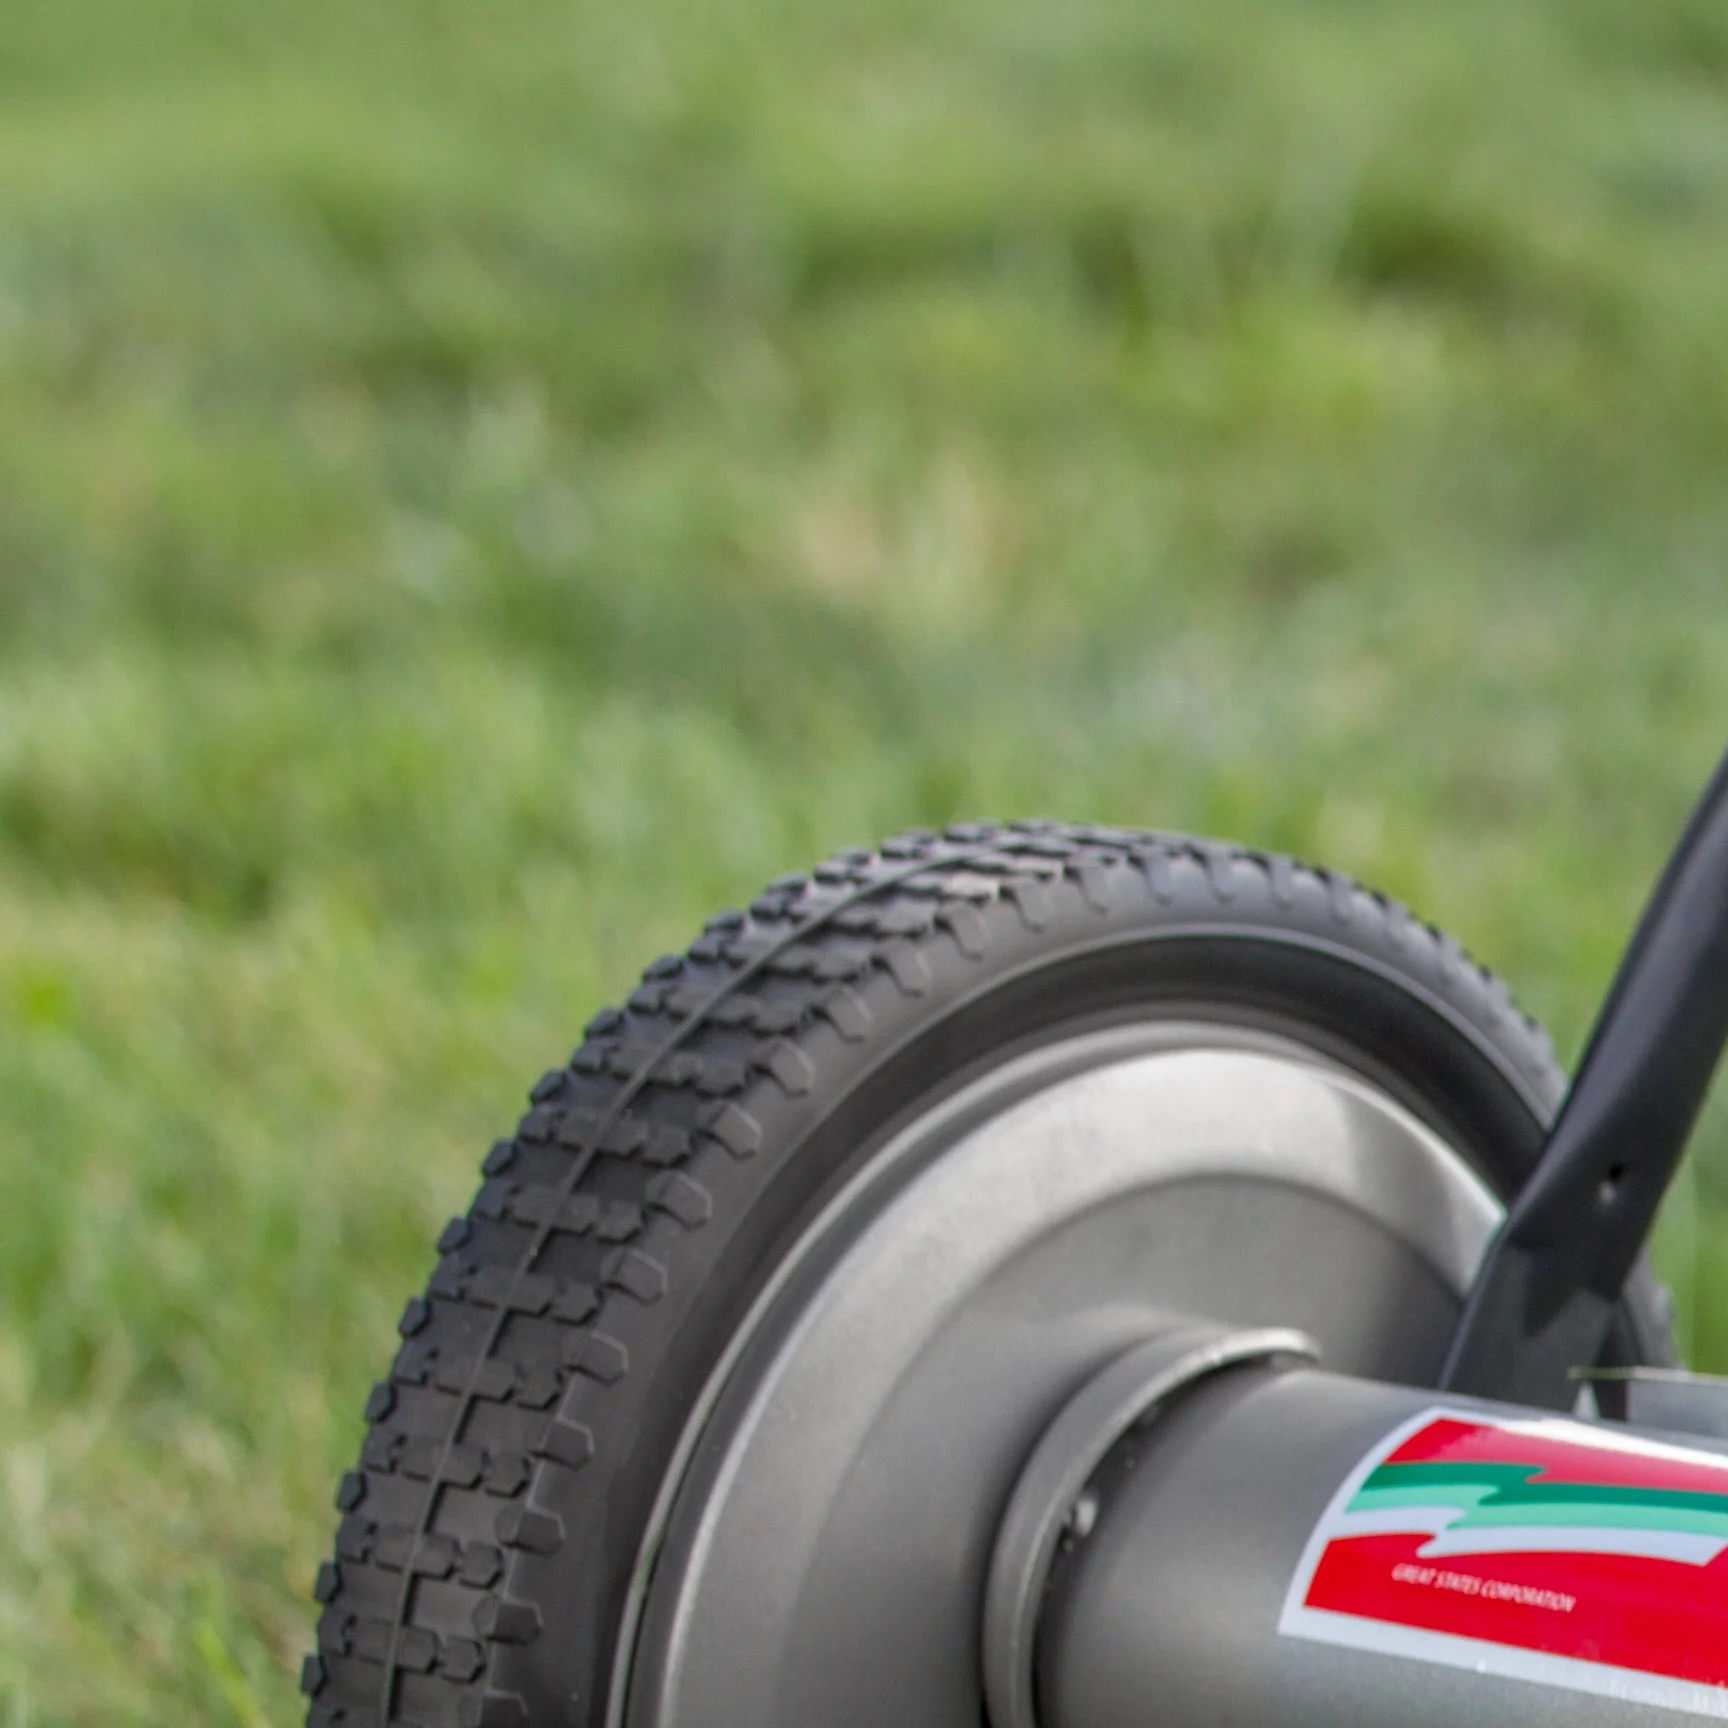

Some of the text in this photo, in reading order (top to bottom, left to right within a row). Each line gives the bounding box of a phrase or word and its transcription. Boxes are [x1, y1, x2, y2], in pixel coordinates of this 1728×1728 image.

[1391, 1562, 1578, 1613] GREAT STATES CORPORATION
